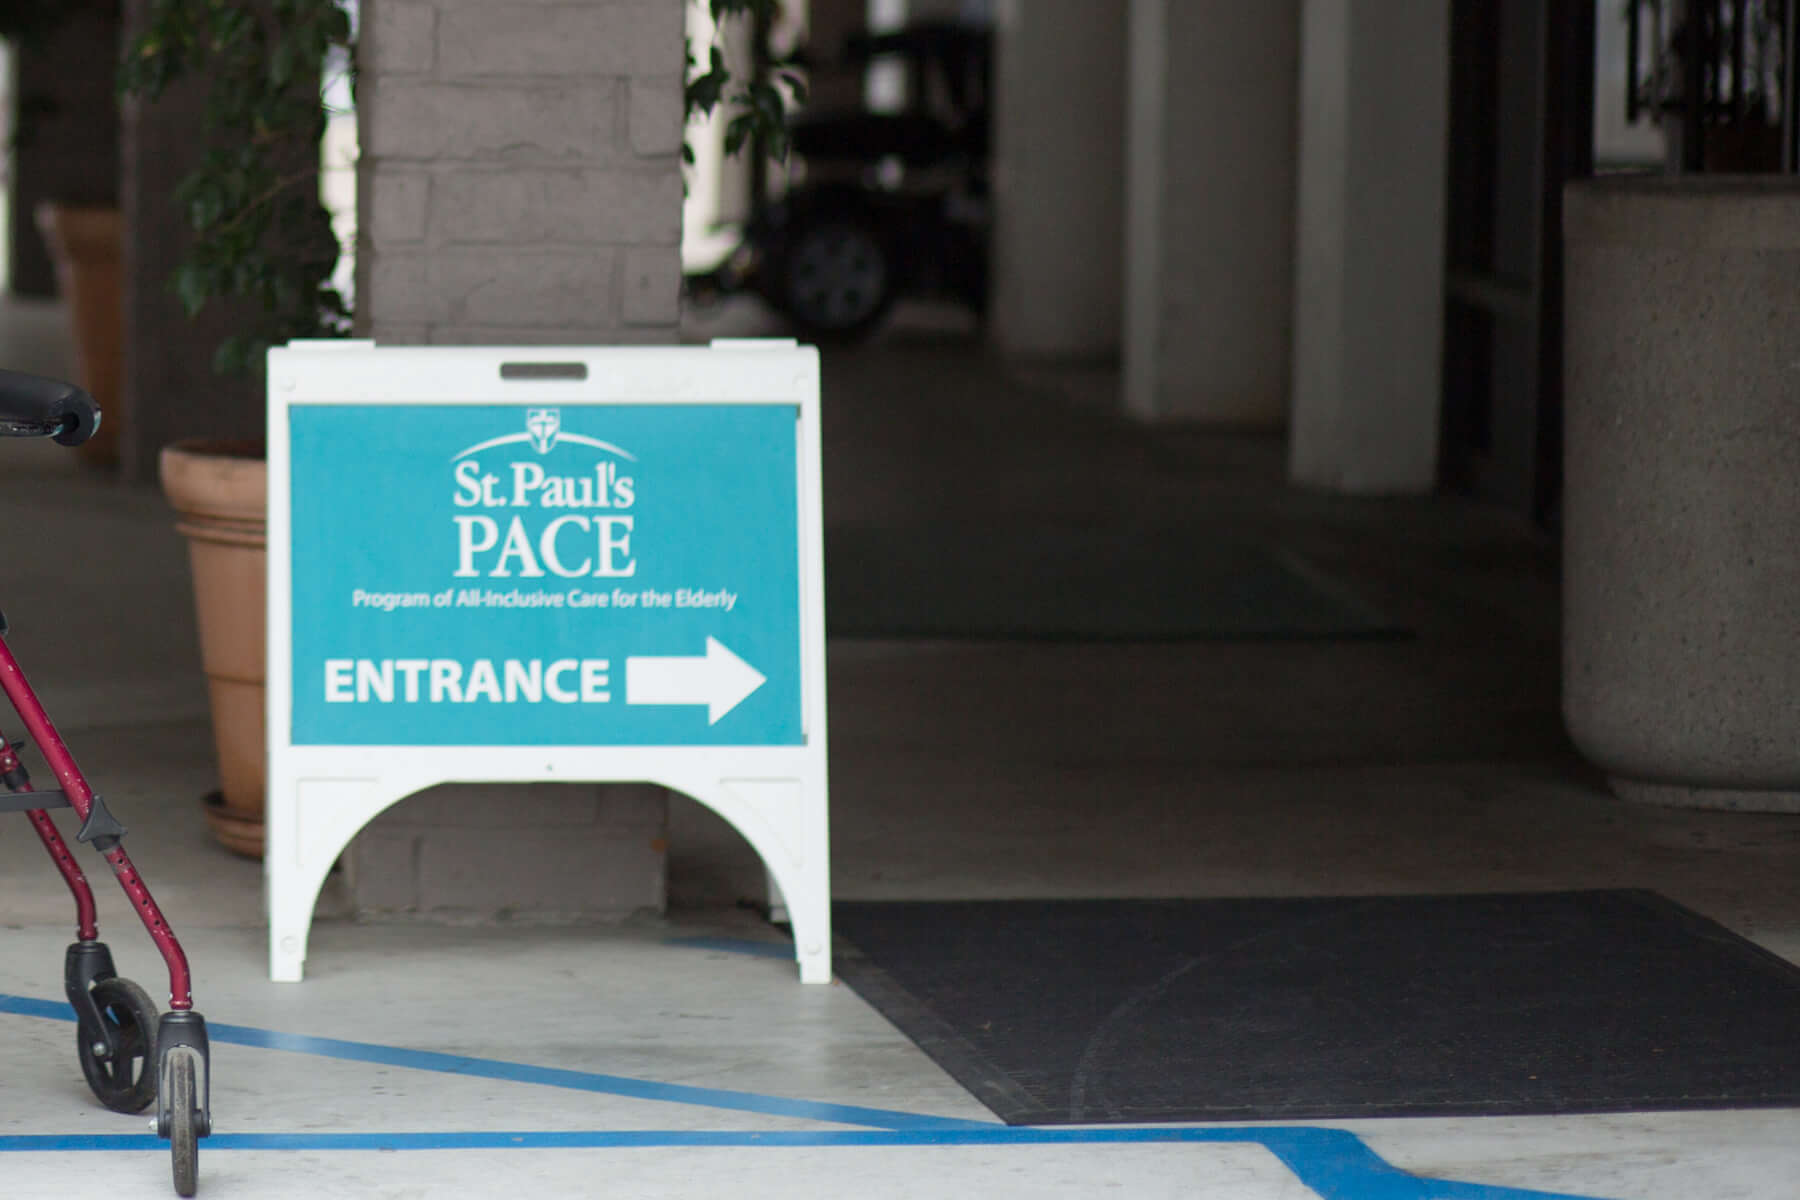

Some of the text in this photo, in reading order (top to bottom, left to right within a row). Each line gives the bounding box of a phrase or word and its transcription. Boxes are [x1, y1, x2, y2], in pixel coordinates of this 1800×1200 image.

[453, 460, 636, 508] St. Paul's
[453, 514, 636, 578] PACE
[352, 588, 738, 612] Program of All-Inclusive Care for the Elderly
[324, 658, 611, 704] ENTRANCE
